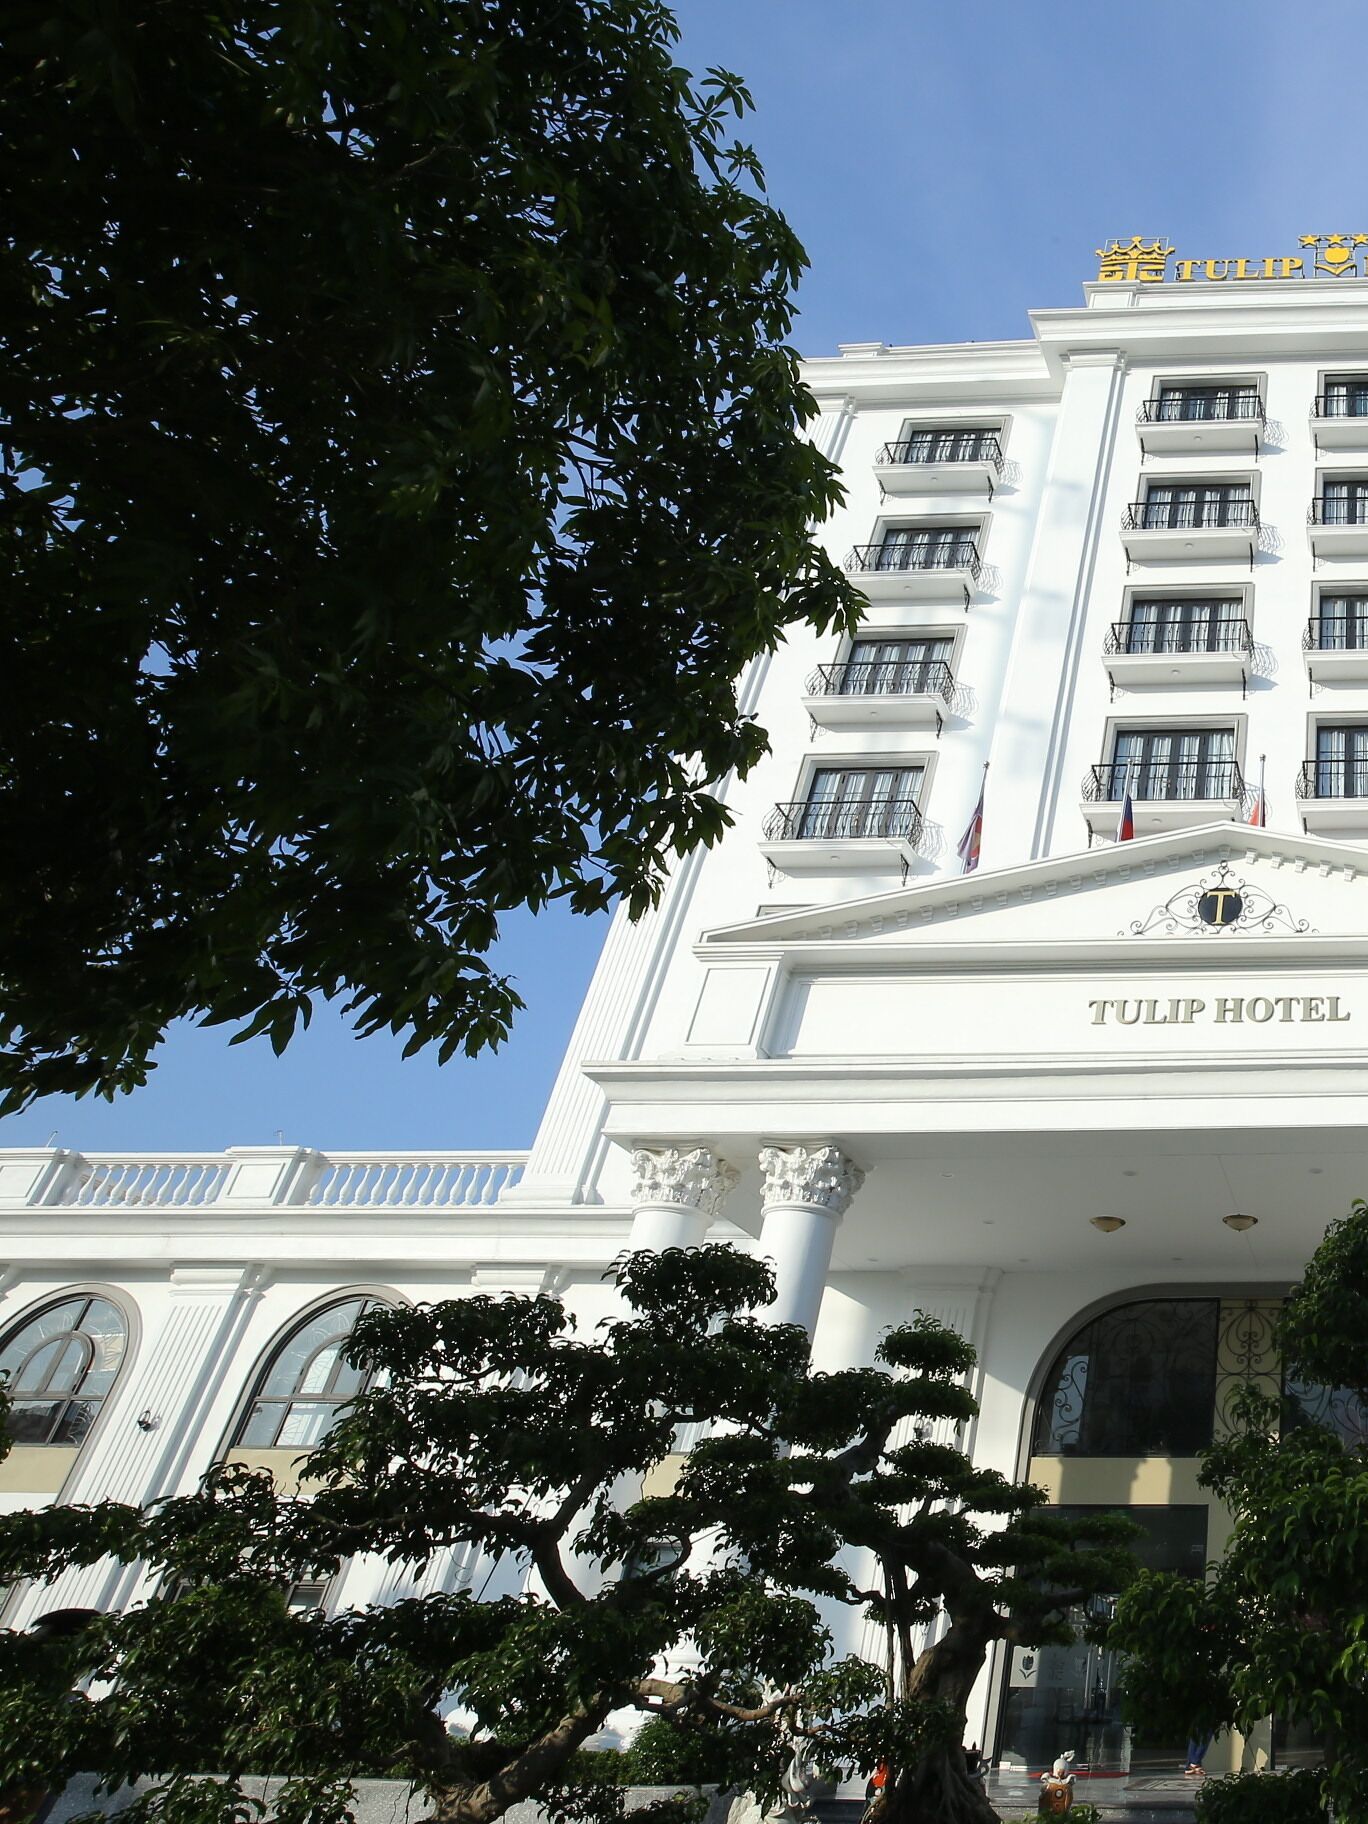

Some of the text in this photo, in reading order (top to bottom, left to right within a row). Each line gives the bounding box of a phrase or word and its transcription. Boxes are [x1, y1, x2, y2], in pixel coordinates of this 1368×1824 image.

[1175, 257, 1304, 281] TULIP
[1206, 890, 1236, 925] T
[1088, 996, 1351, 1025] TULIP HOTEL
